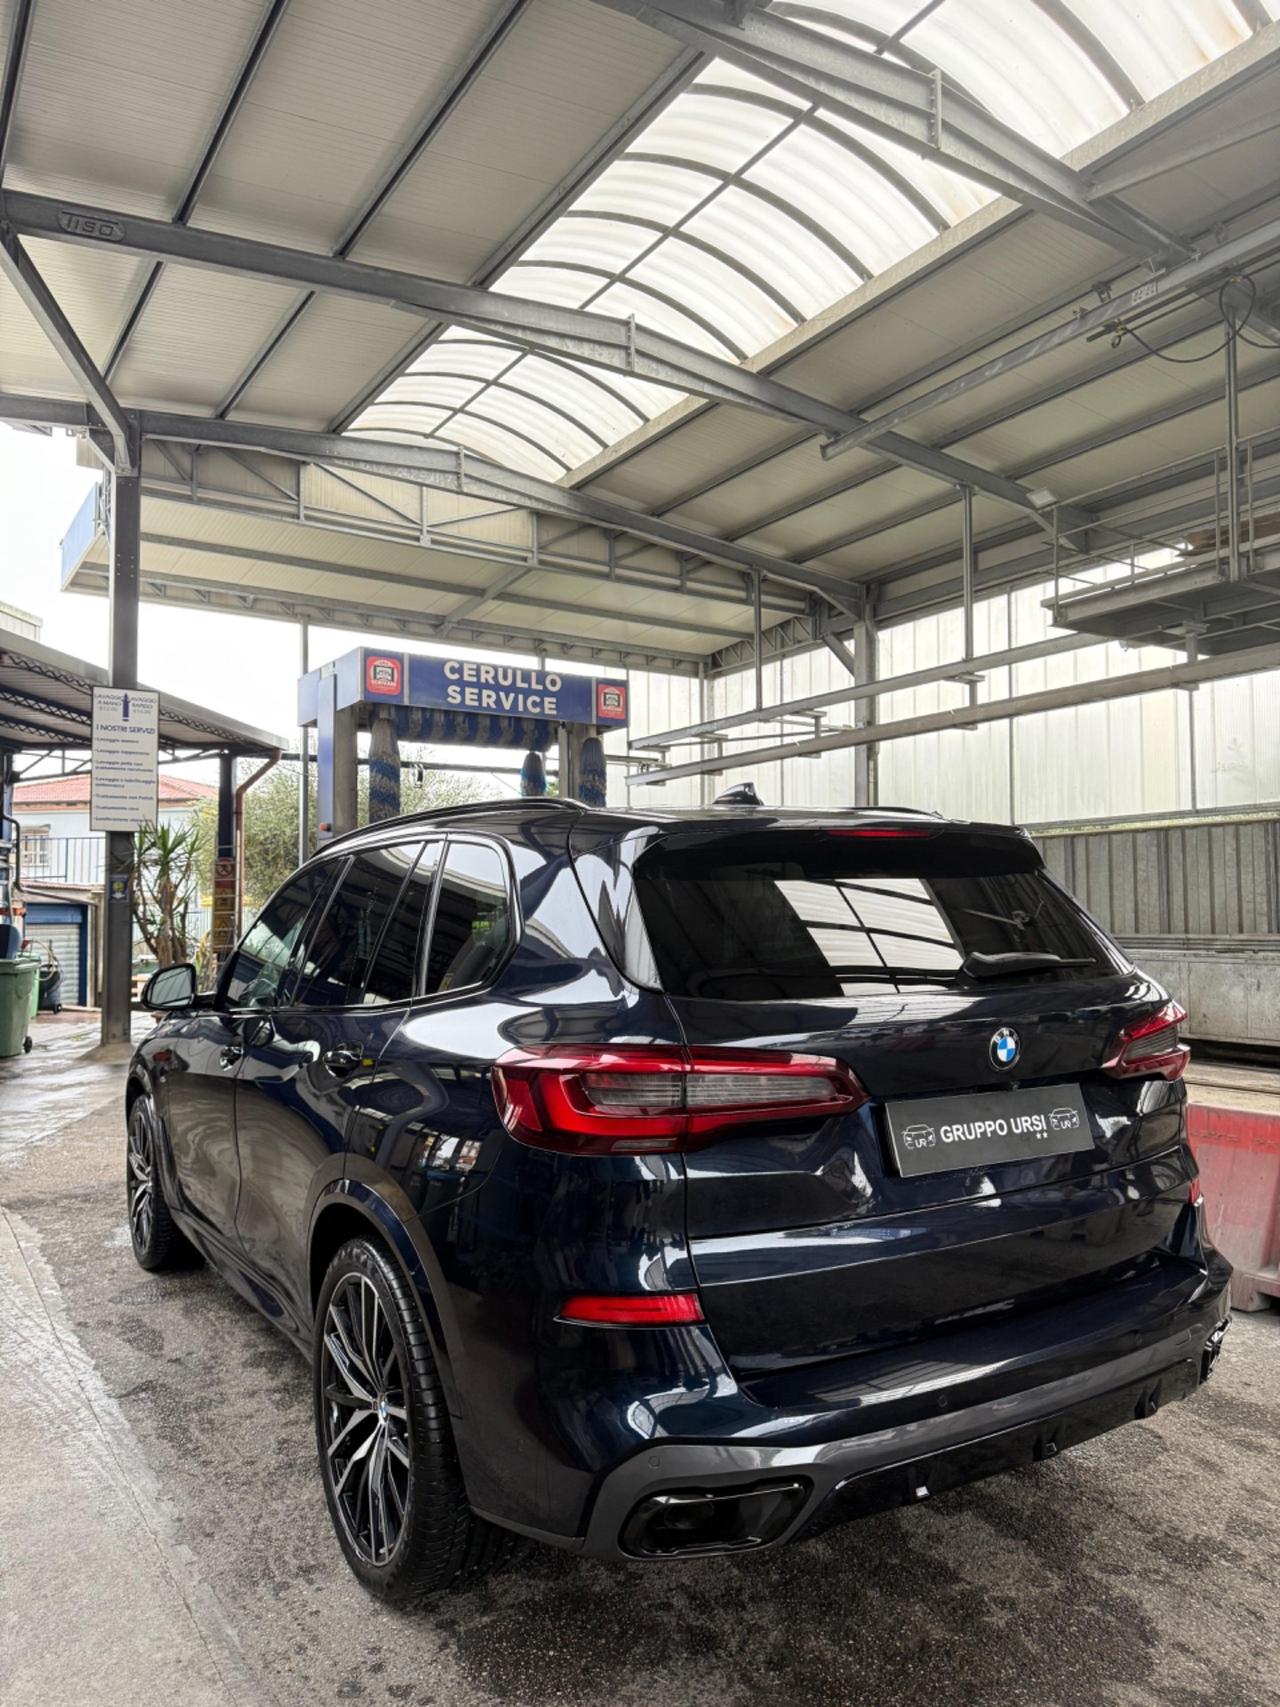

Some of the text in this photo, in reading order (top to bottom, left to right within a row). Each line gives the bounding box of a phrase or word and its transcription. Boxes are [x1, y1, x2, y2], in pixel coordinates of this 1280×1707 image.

[443, 660, 562, 692] CERULLO
[447, 685, 558, 715] SERVICE
[100, 724, 128, 732] NOSTRI
[128, 726, 156, 735] SERVIZI
[940, 1114, 1048, 1143] GRUPPO URSI
